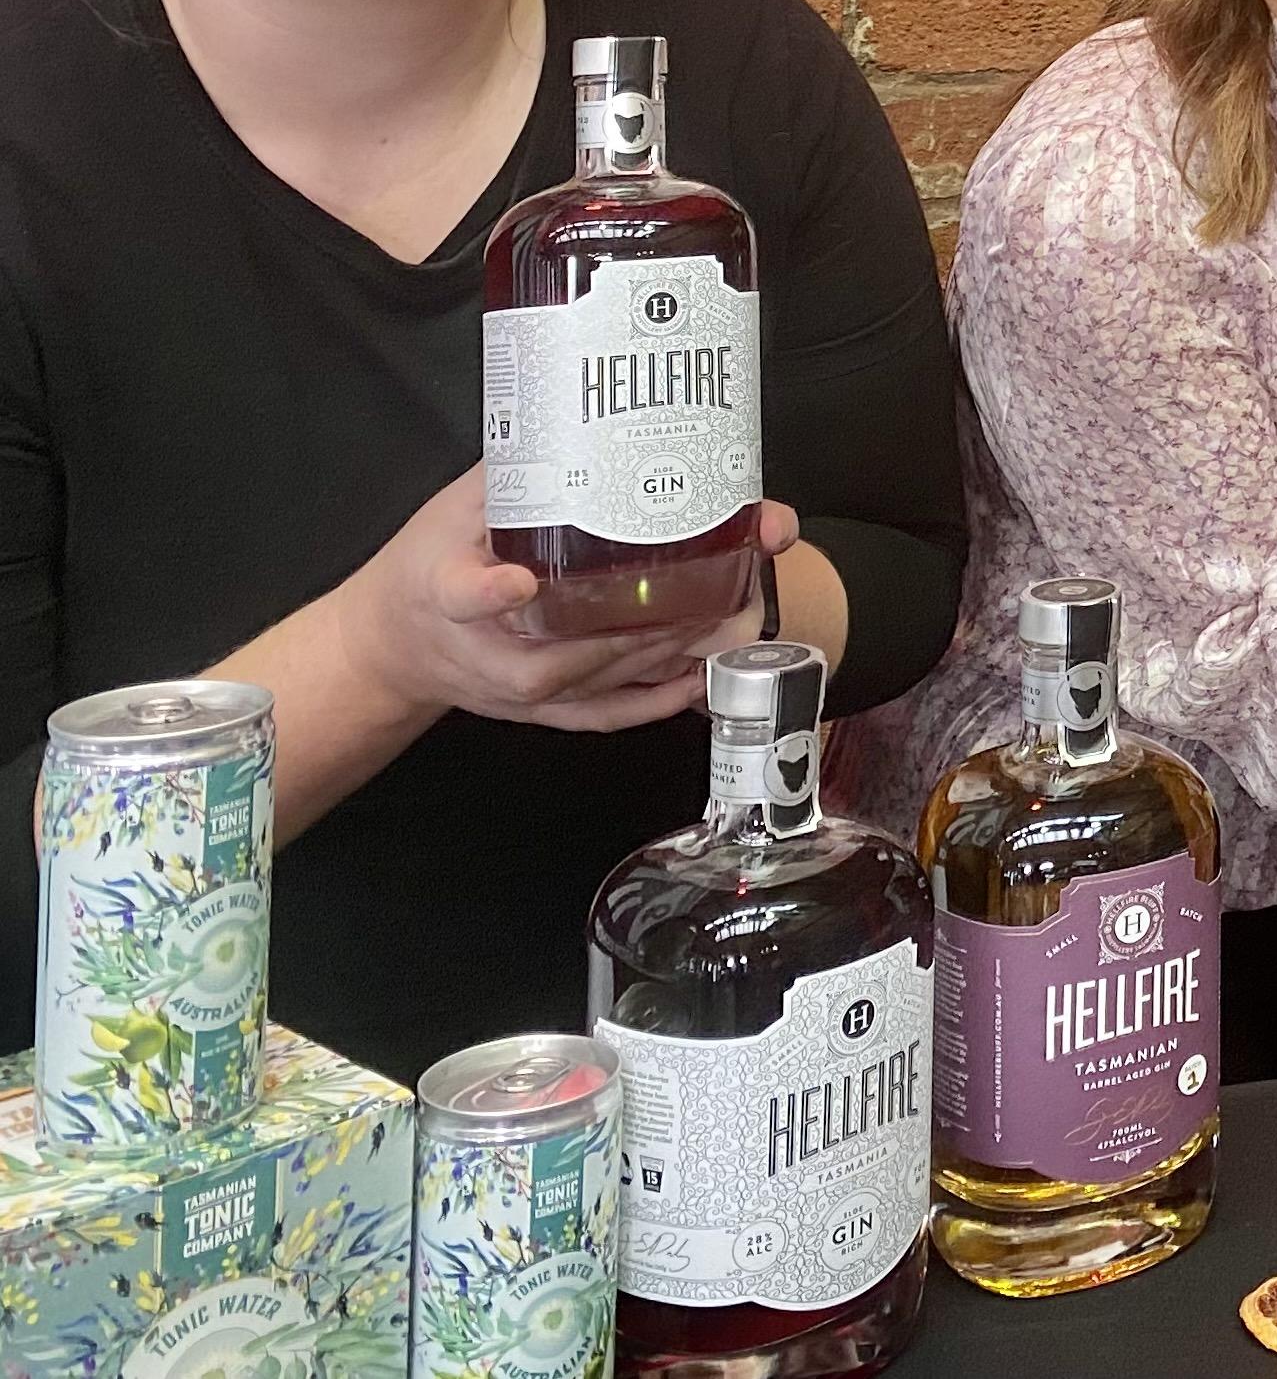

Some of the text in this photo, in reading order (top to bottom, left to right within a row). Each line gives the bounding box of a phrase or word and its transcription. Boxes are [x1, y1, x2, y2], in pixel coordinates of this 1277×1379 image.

[650, 297, 672, 319] H
[582, 345, 733, 423] HELLFIRE
[626, 423, 698, 438] TASMANIA
[729, 453, 746, 462] 700
[732, 461, 744, 470] ML
[566, 478, 589, 487] ALC
[643, 475, 684, 494] GIN
[653, 496, 675, 504] RICH
[209, 805, 250, 835] TONIC
[182, 900, 224, 934] TONIC
[1123, 911, 1144, 937] H
[1179, 907, 1204, 923] BATCH
[1045, 934, 1079, 959] SMALL
[169, 970, 260, 1021] AUSTRALIAN
[1045, 948, 1201, 1062] HELLFIRE
[848, 1005, 869, 1034] H
[772, 1040, 803, 1067] SMALL
[1074, 1038, 1179, 1077] TASMANIAN
[1083, 1060, 1171, 1092] BARREL AGED GIN
[1186, 1070, 1200, 1091] 1
[768, 1039, 921, 1178] HELLFIRE
[1112, 1122, 1143, 1138] 700ML
[646, 1171, 659, 1185] 15
[818, 1147, 888, 1185] TASMANIA
[184, 1175, 257, 1210] TASMANIAN
[535, 1179, 579, 1208] TONIC
[184, 1191, 256, 1241] TONIC
[535, 1198, 579, 1219] COMPANY
[183, 1219, 255, 1258] COMPANY
[747, 1233, 773, 1246] 28%
[832, 1213, 873, 1246] GIN
[746, 1244, 773, 1258] ALC
[841, 1242, 864, 1256] RICH
[509, 1262, 594, 1301] TONIC WATER
[149, 1294, 282, 1357] TONIC WATER
